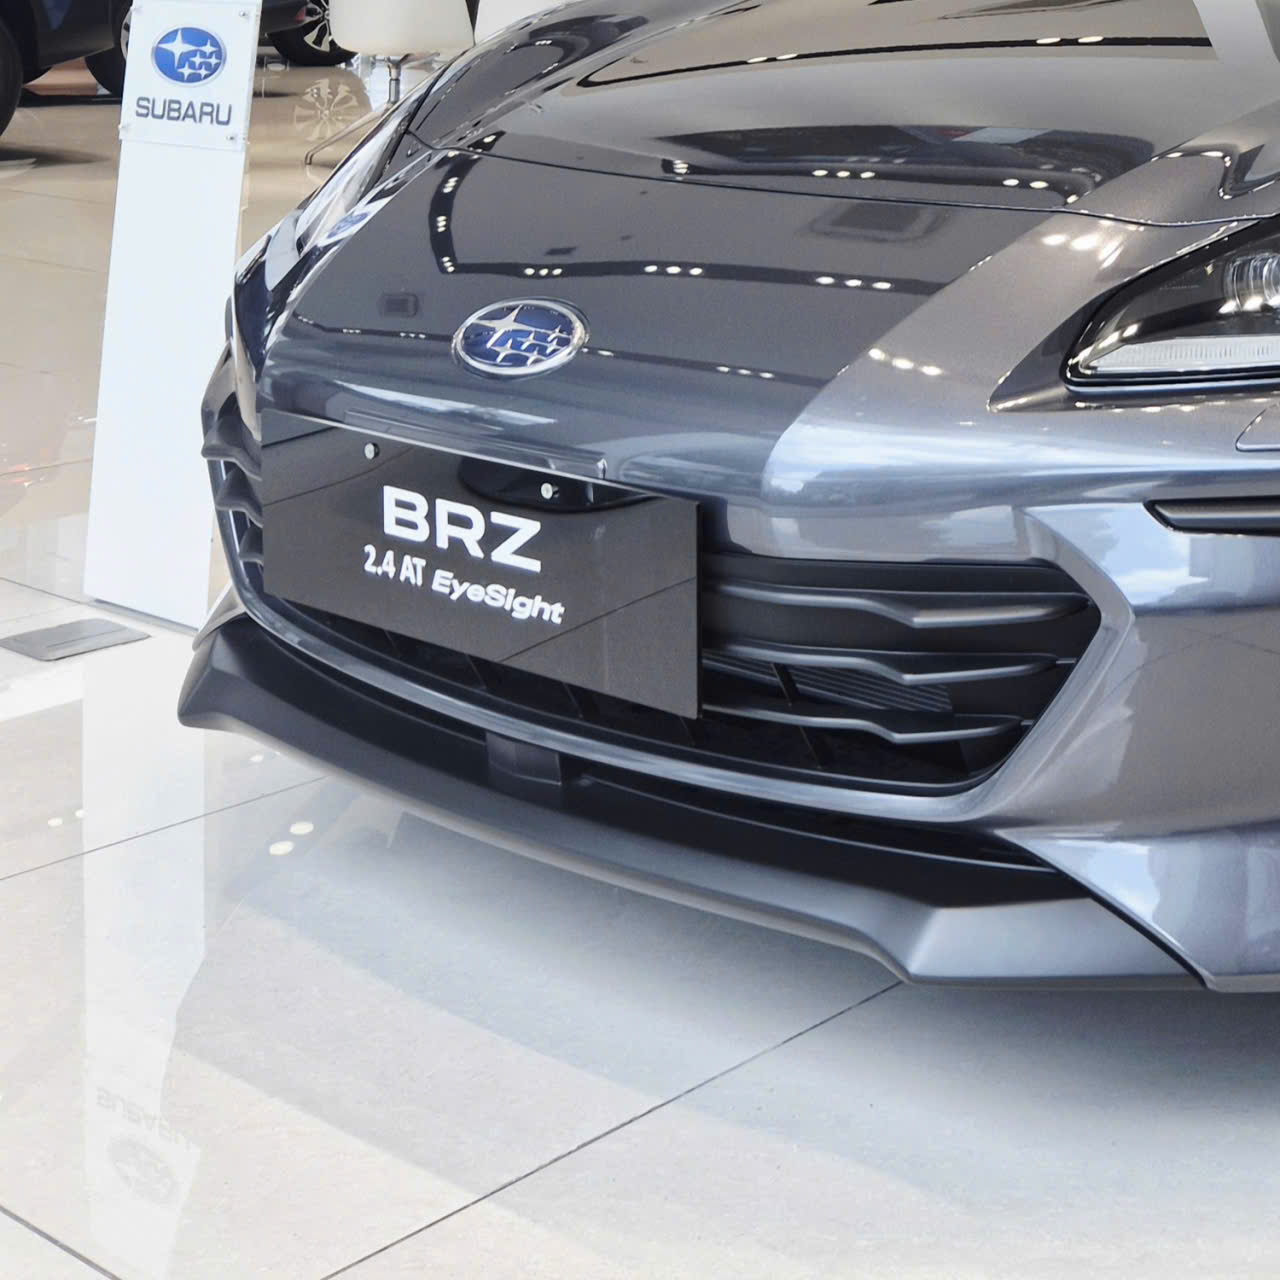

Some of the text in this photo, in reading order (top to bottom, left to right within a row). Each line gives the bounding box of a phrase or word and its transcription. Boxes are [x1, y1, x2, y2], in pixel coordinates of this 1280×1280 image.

[135, 96, 232, 126] SUBARU
[382, 485, 542, 573] BRZ
[364, 544, 566, 624] 2.4 AT EyeSight
